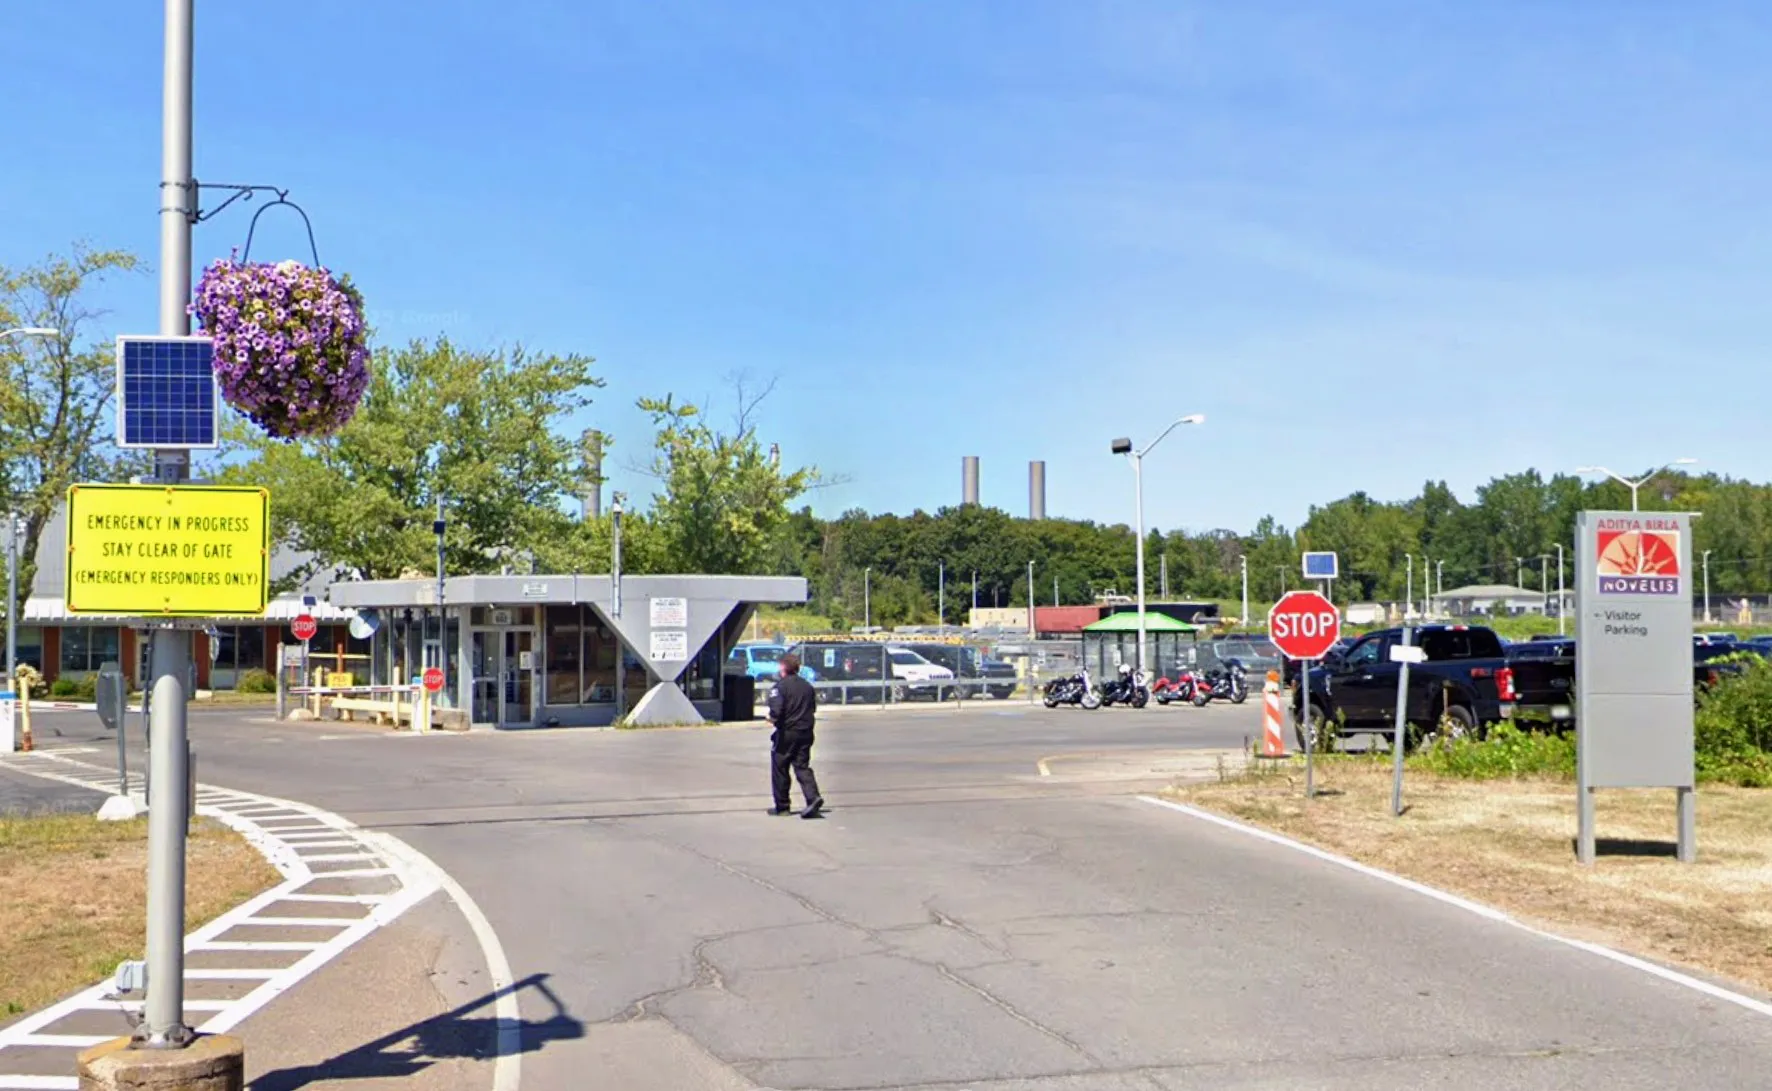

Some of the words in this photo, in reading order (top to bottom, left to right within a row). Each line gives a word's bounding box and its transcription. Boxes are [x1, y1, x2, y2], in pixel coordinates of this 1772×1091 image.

[87, 515, 162, 531] EMERGENCY
[167, 515, 181, 530] IN
[186, 515, 250, 532] PROGRESS
[1597, 519, 1640, 530] ADITYA
[1645, 519, 1679, 530] BIRLA
[102, 542, 132, 557] STAY
[138, 543, 178, 557] CLEAR
[182, 543, 198, 558] OF
[203, 543, 233, 559] GATE
[75, 571, 146, 585] (EMERGENCY
[150, 572, 221, 586] RESPONDERS
[225, 572, 259, 587] ONLY)
[1603, 579, 1675, 592] NOVELIS
[1604, 611, 1642, 621] Visitor
[293, 620, 315, 632] STOP
[1275, 612, 1334, 637] STOP
[1604, 625, 1648, 637] Parking
[423, 674, 444, 685] STOP
